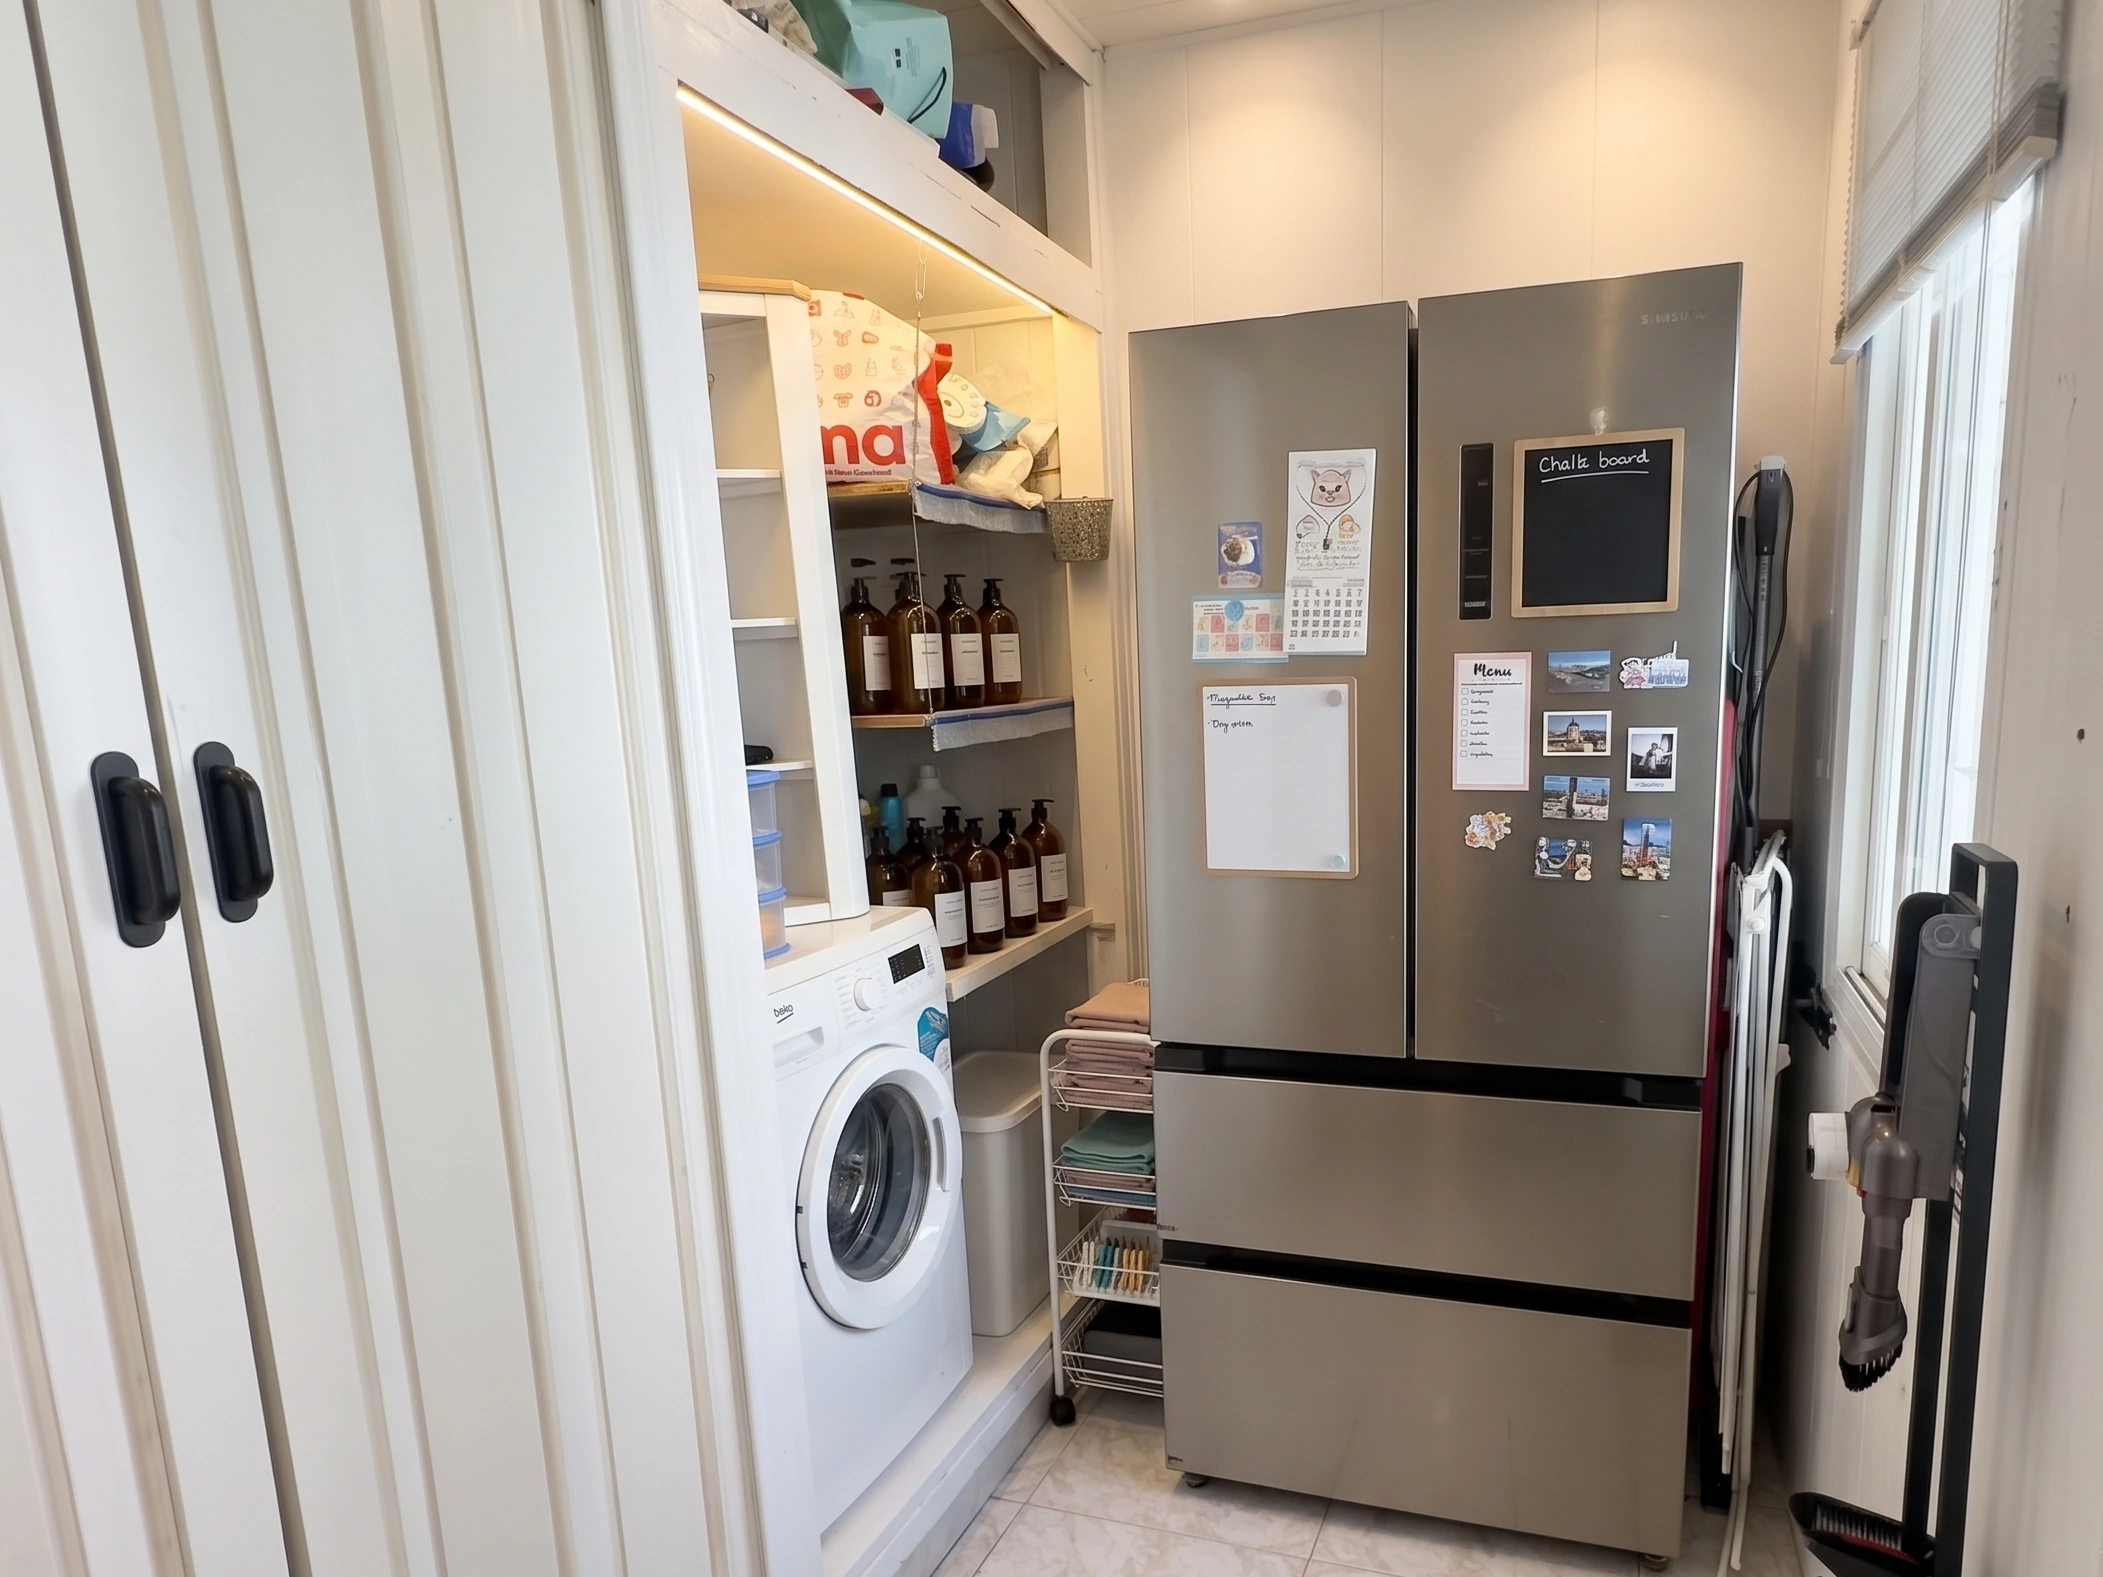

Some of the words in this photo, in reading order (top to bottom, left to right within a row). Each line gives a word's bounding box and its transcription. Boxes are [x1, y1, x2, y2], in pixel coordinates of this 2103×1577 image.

[1539, 453, 1590, 473] Chalk
[1599, 448, 1650, 469] board
[1473, 663, 1512, 677] Menu
[773, 1004, 794, 1018] beko
